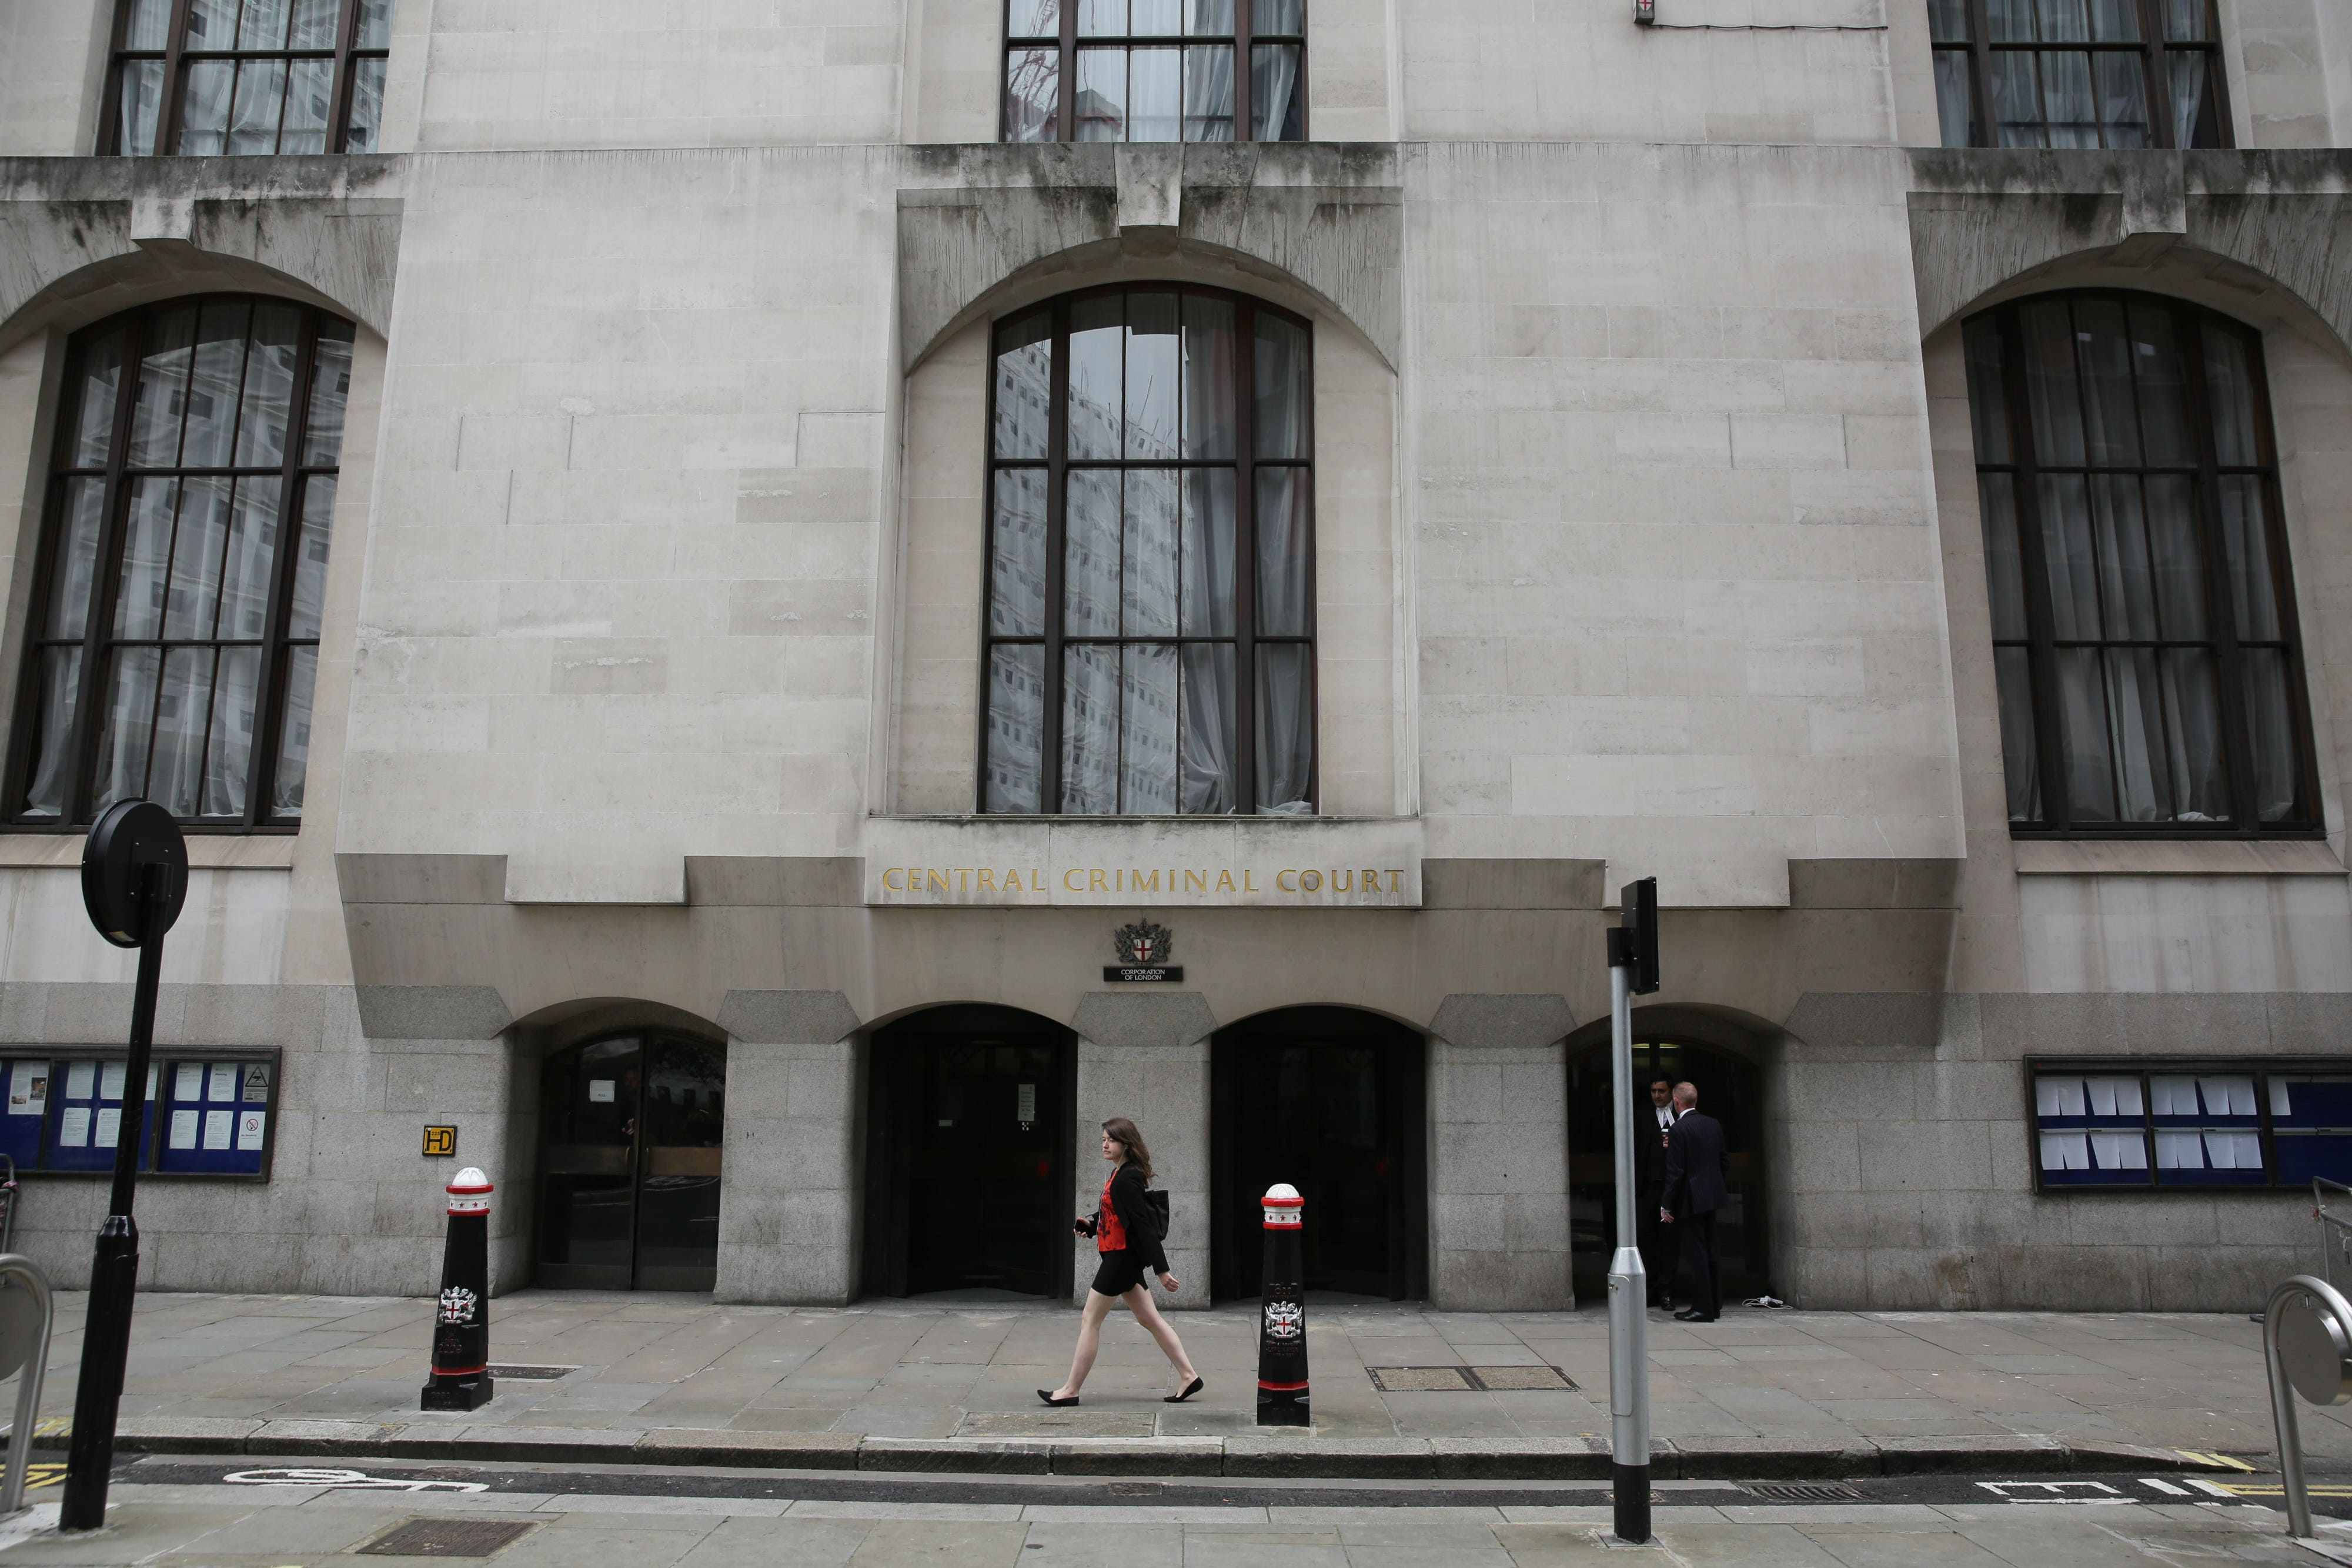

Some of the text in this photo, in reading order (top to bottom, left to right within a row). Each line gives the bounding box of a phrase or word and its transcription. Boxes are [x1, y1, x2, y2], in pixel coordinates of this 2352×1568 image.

[882, 868, 1405, 893] CENTRAL CRIMINAL COURT
[427, 1129, 452, 1151] HD
